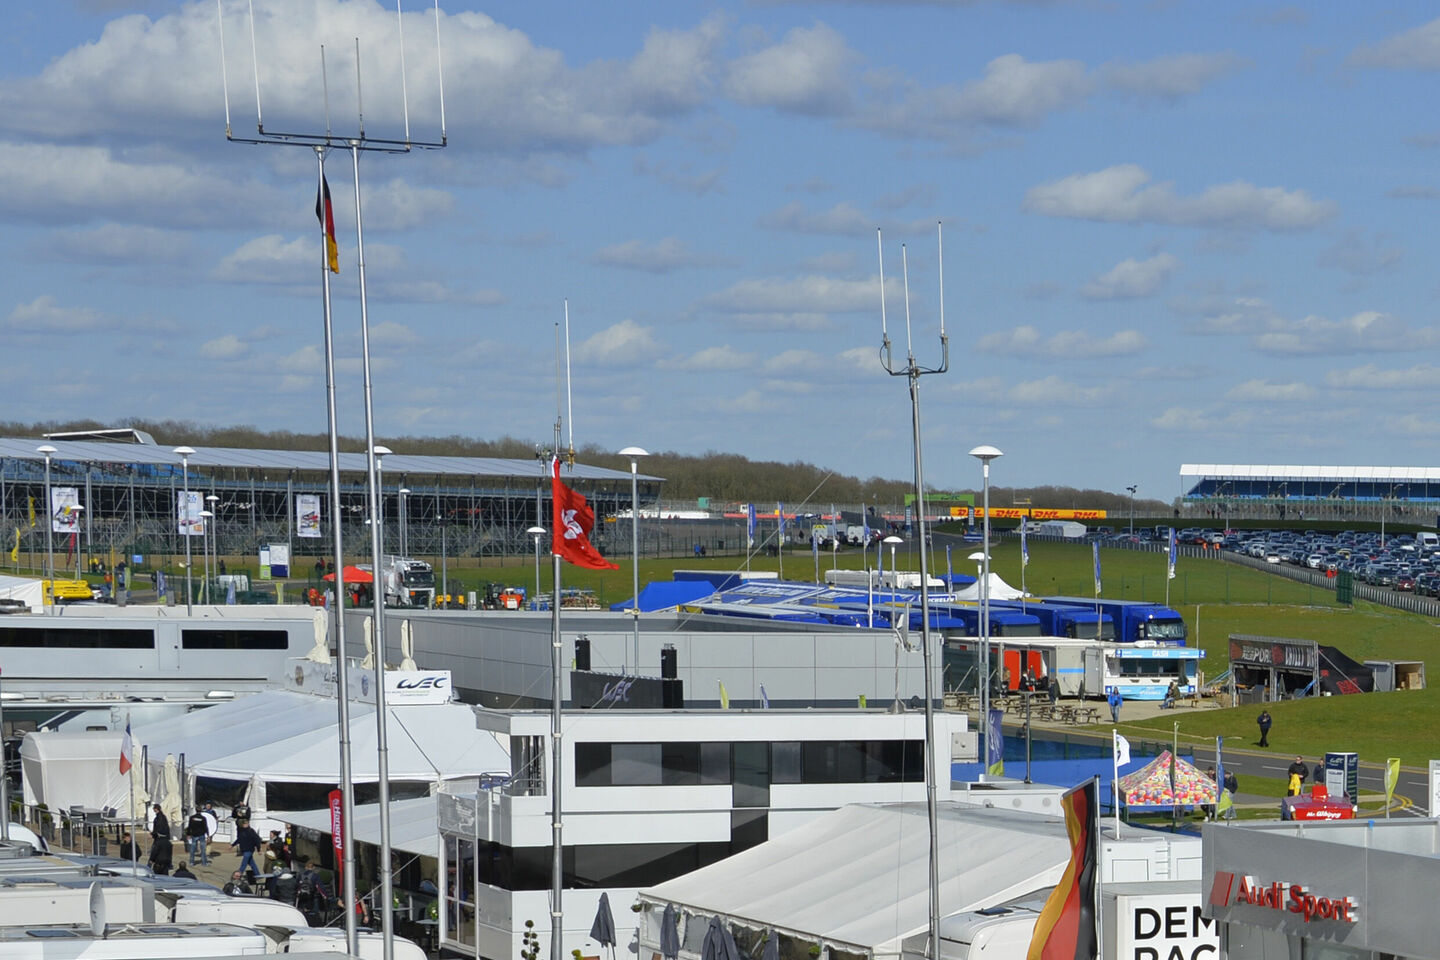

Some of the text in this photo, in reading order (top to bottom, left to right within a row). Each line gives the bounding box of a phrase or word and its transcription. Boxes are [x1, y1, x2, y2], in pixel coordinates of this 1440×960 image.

[995, 510, 1021, 518] DHL
[1034, 510, 1060, 518] DHL
[1073, 511, 1098, 519] DHL
[396, 677, 448, 689] WEC
[1236, 875, 1355, 923] Audi Sport
[1134, 906, 1220, 941] DEM
